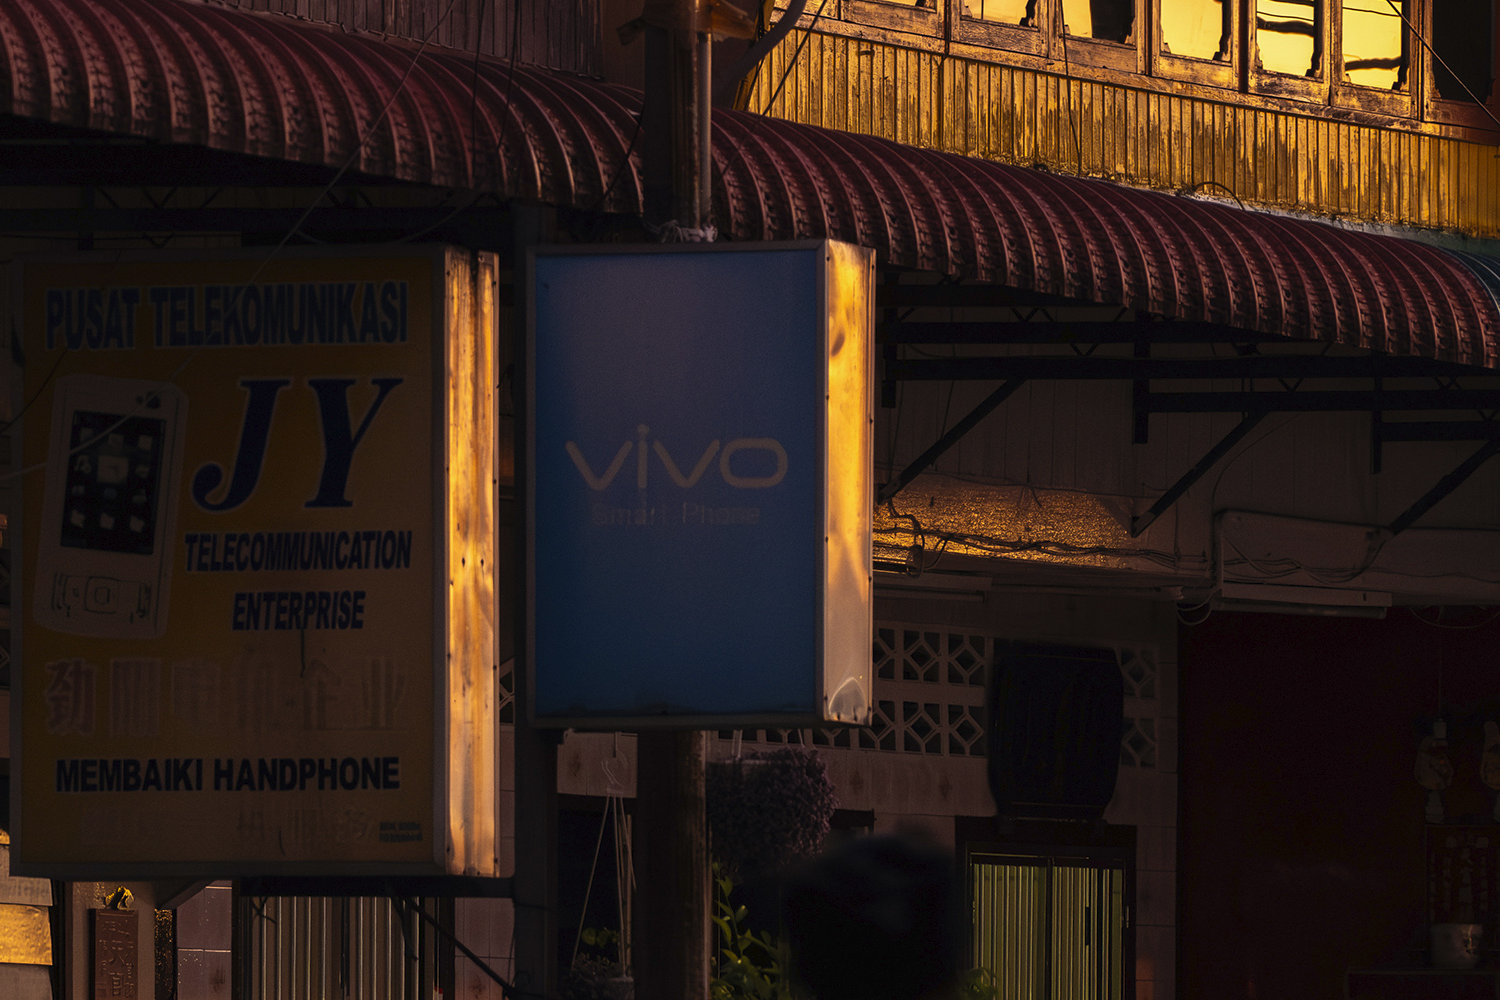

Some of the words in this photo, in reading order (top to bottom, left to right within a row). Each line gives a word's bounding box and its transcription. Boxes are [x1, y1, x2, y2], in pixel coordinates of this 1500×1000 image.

[45, 287, 140, 351] PUSAT
[147, 280, 408, 349] TELEKOMUNIKASI
[191, 377, 404, 514] JY
[564, 423, 789, 491] vivo
[185, 530, 412, 574] TELECOMMUNICATION
[232, 590, 367, 631] ENTERPRISE
[55, 758, 204, 793] MEMBAIKI
[213, 756, 401, 792] HANDPHONE
